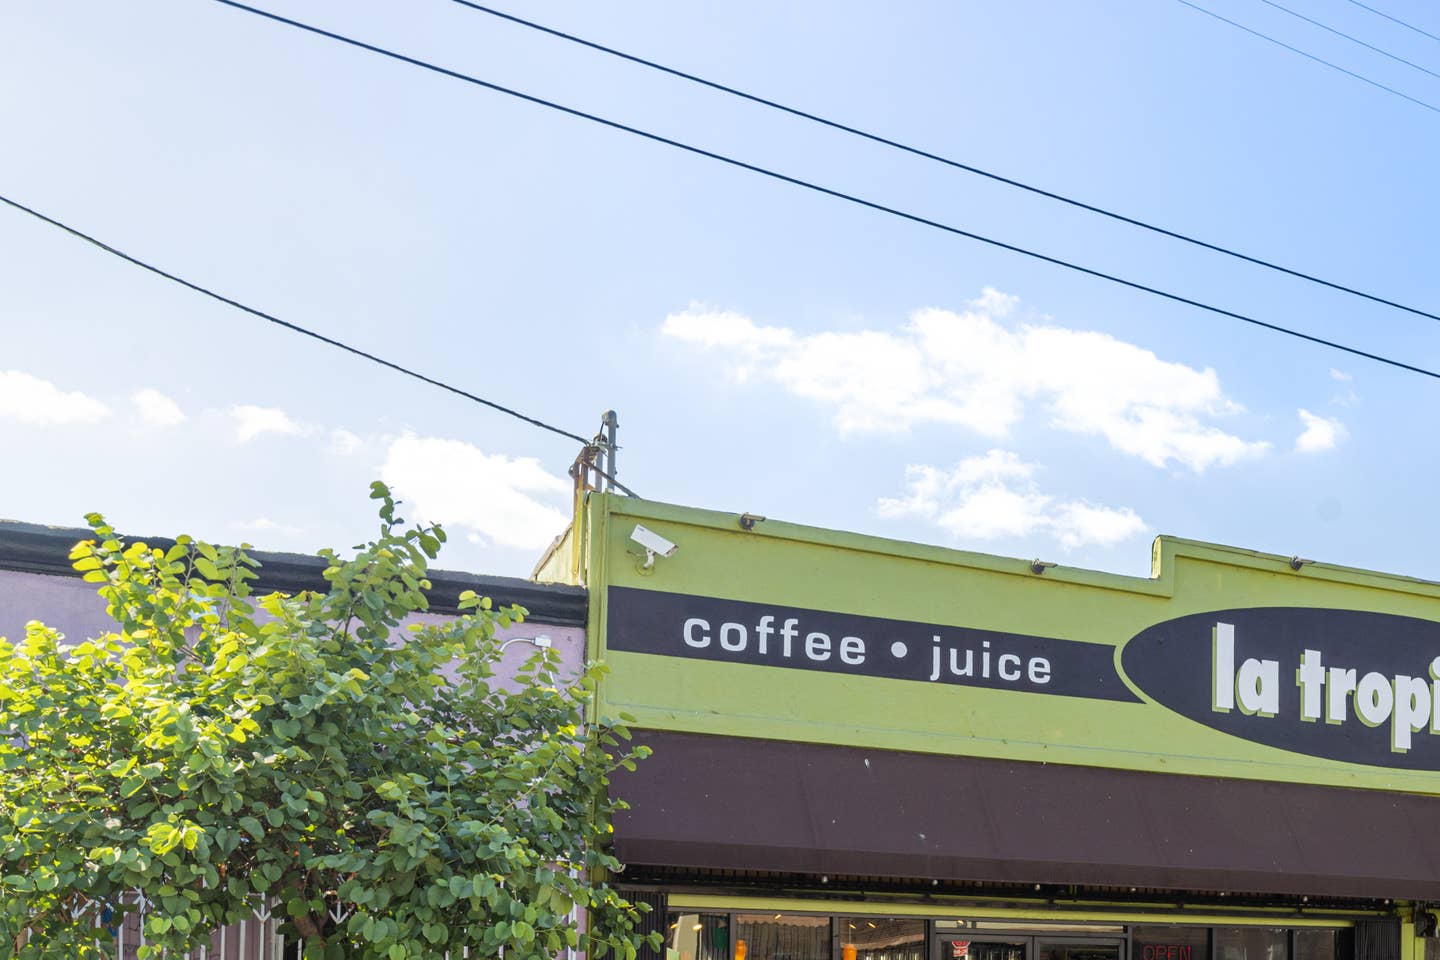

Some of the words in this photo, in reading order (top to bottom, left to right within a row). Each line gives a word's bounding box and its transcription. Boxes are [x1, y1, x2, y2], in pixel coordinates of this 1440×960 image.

[682, 615, 866, 666] coffee
[929, 635, 1052, 682] juice
[1214, 621, 1281, 714] la
